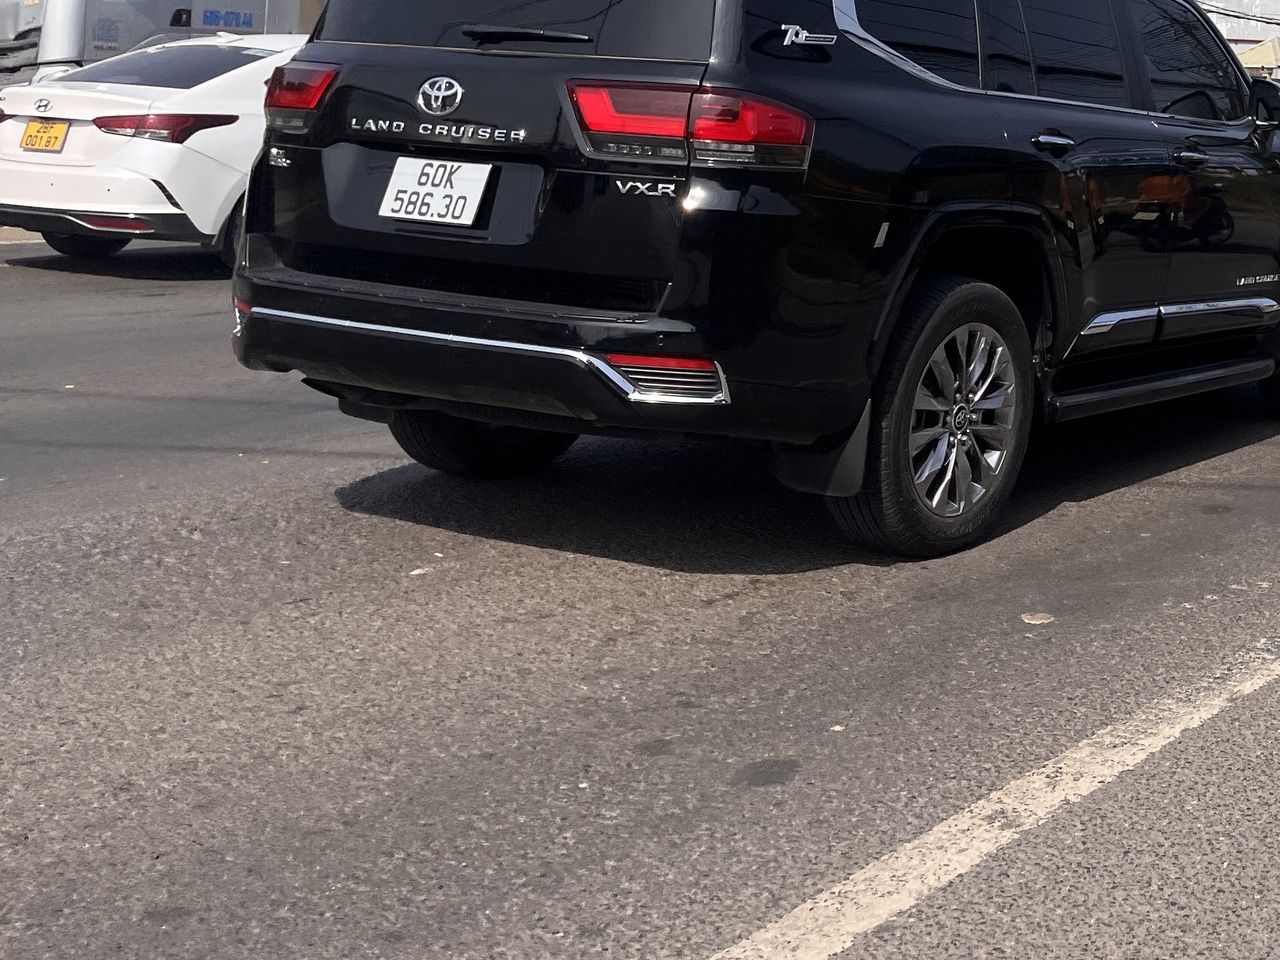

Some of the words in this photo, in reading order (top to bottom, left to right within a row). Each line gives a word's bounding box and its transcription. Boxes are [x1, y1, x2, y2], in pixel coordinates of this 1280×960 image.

[25, 135, 58, 148] 001.87
[351, 118, 405, 132] LAND
[418, 124, 526, 142] CRUISER
[417, 162, 462, 189] 60K
[615, 180, 676, 197] VXR
[391, 189, 467, 220] 586.30
